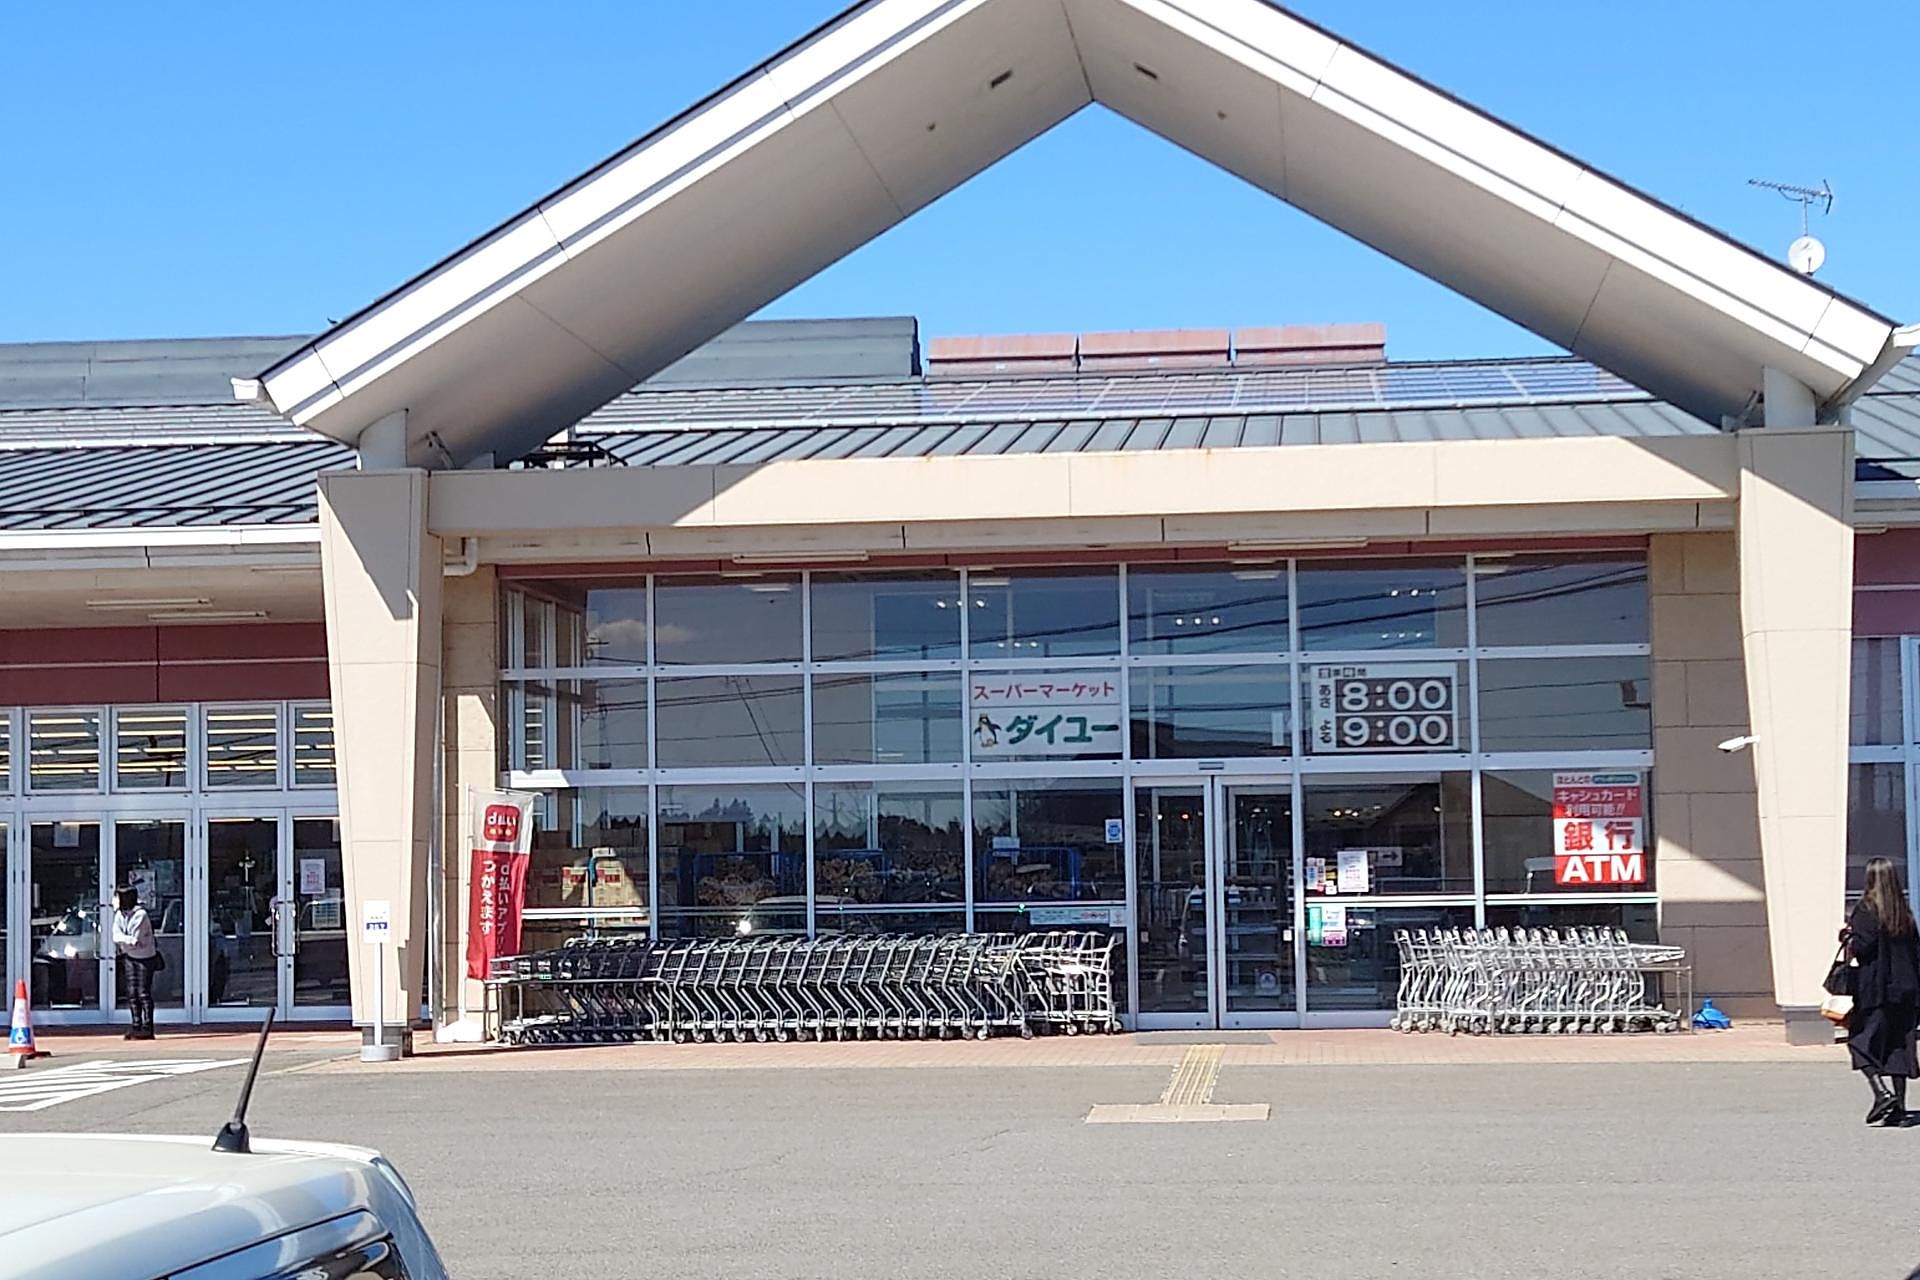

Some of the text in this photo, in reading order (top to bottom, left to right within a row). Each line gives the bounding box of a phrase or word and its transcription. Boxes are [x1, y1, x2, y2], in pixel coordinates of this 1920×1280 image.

[974, 681, 1115, 700] スーパーマーケット
[1342, 680, 1447, 711] 8:00
[1006, 714, 1119, 745] ダイユー
[1342, 715, 1448, 746] 9:00
[1564, 821, 1635, 851] 銀行
[1561, 855, 1642, 882] ATM
[480, 859, 496, 935] つかえます
